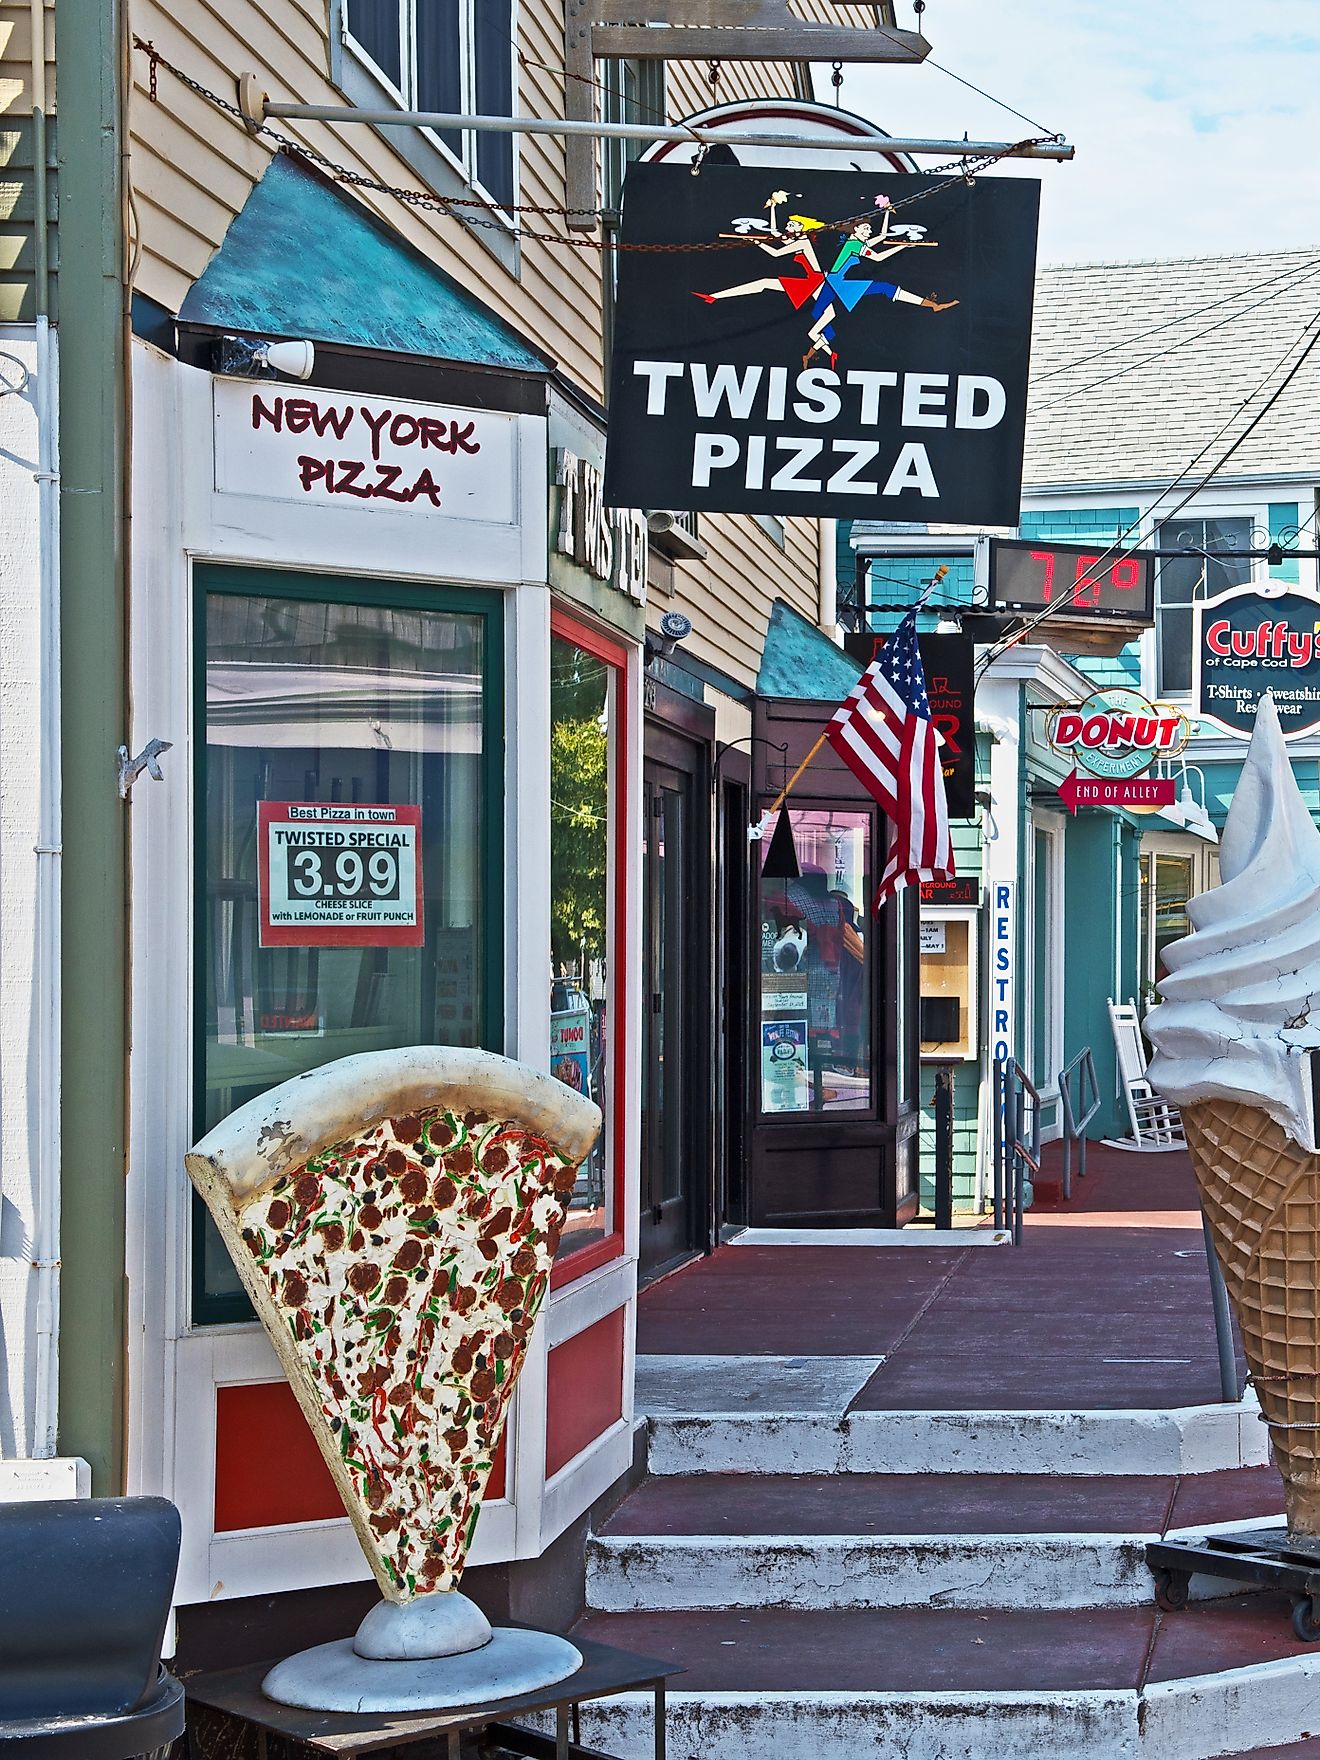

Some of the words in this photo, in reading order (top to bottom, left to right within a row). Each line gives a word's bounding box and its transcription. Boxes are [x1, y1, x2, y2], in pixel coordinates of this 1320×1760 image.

[632, 359, 1007, 431] TWISTED
[252, 394, 354, 440] NEW
[360, 406, 481, 461] YORK
[691, 433, 941, 498] PIZZA
[297, 455, 441, 508] PIZZA
[1206, 657, 1219, 667] of
[1223, 658, 1258, 669] Cape
[1261, 658, 1288, 668] Cod
[1207, 685, 1253, 699] T-Shirts
[1109, 696, 1128, 708] THE
[1056, 714, 1181, 748] DONUT
[1085, 753, 1144, 774] EXPERIMENT
[1076, 786, 1099, 798] END
[1104, 786, 1118, 798] OF
[1123, 786, 1159, 798] ALLEY
[290, 807, 317, 818] Best
[320, 807, 350, 819] Pizza
[354, 808, 364, 819] in
[368, 810, 395, 820] town
[275, 831, 345, 846] TWISTED
[349, 832, 409, 847] SPECIAL
[294, 850, 397, 896] 3.99
[315, 900, 347, 909] CHEESE
[349, 900, 372, 909] SLICE
[272, 912, 292, 921] with
[294, 912, 344, 921] LEMONADE
[356, 912, 381, 921] FRUIT
[383, 912, 414, 921] PUNCH
